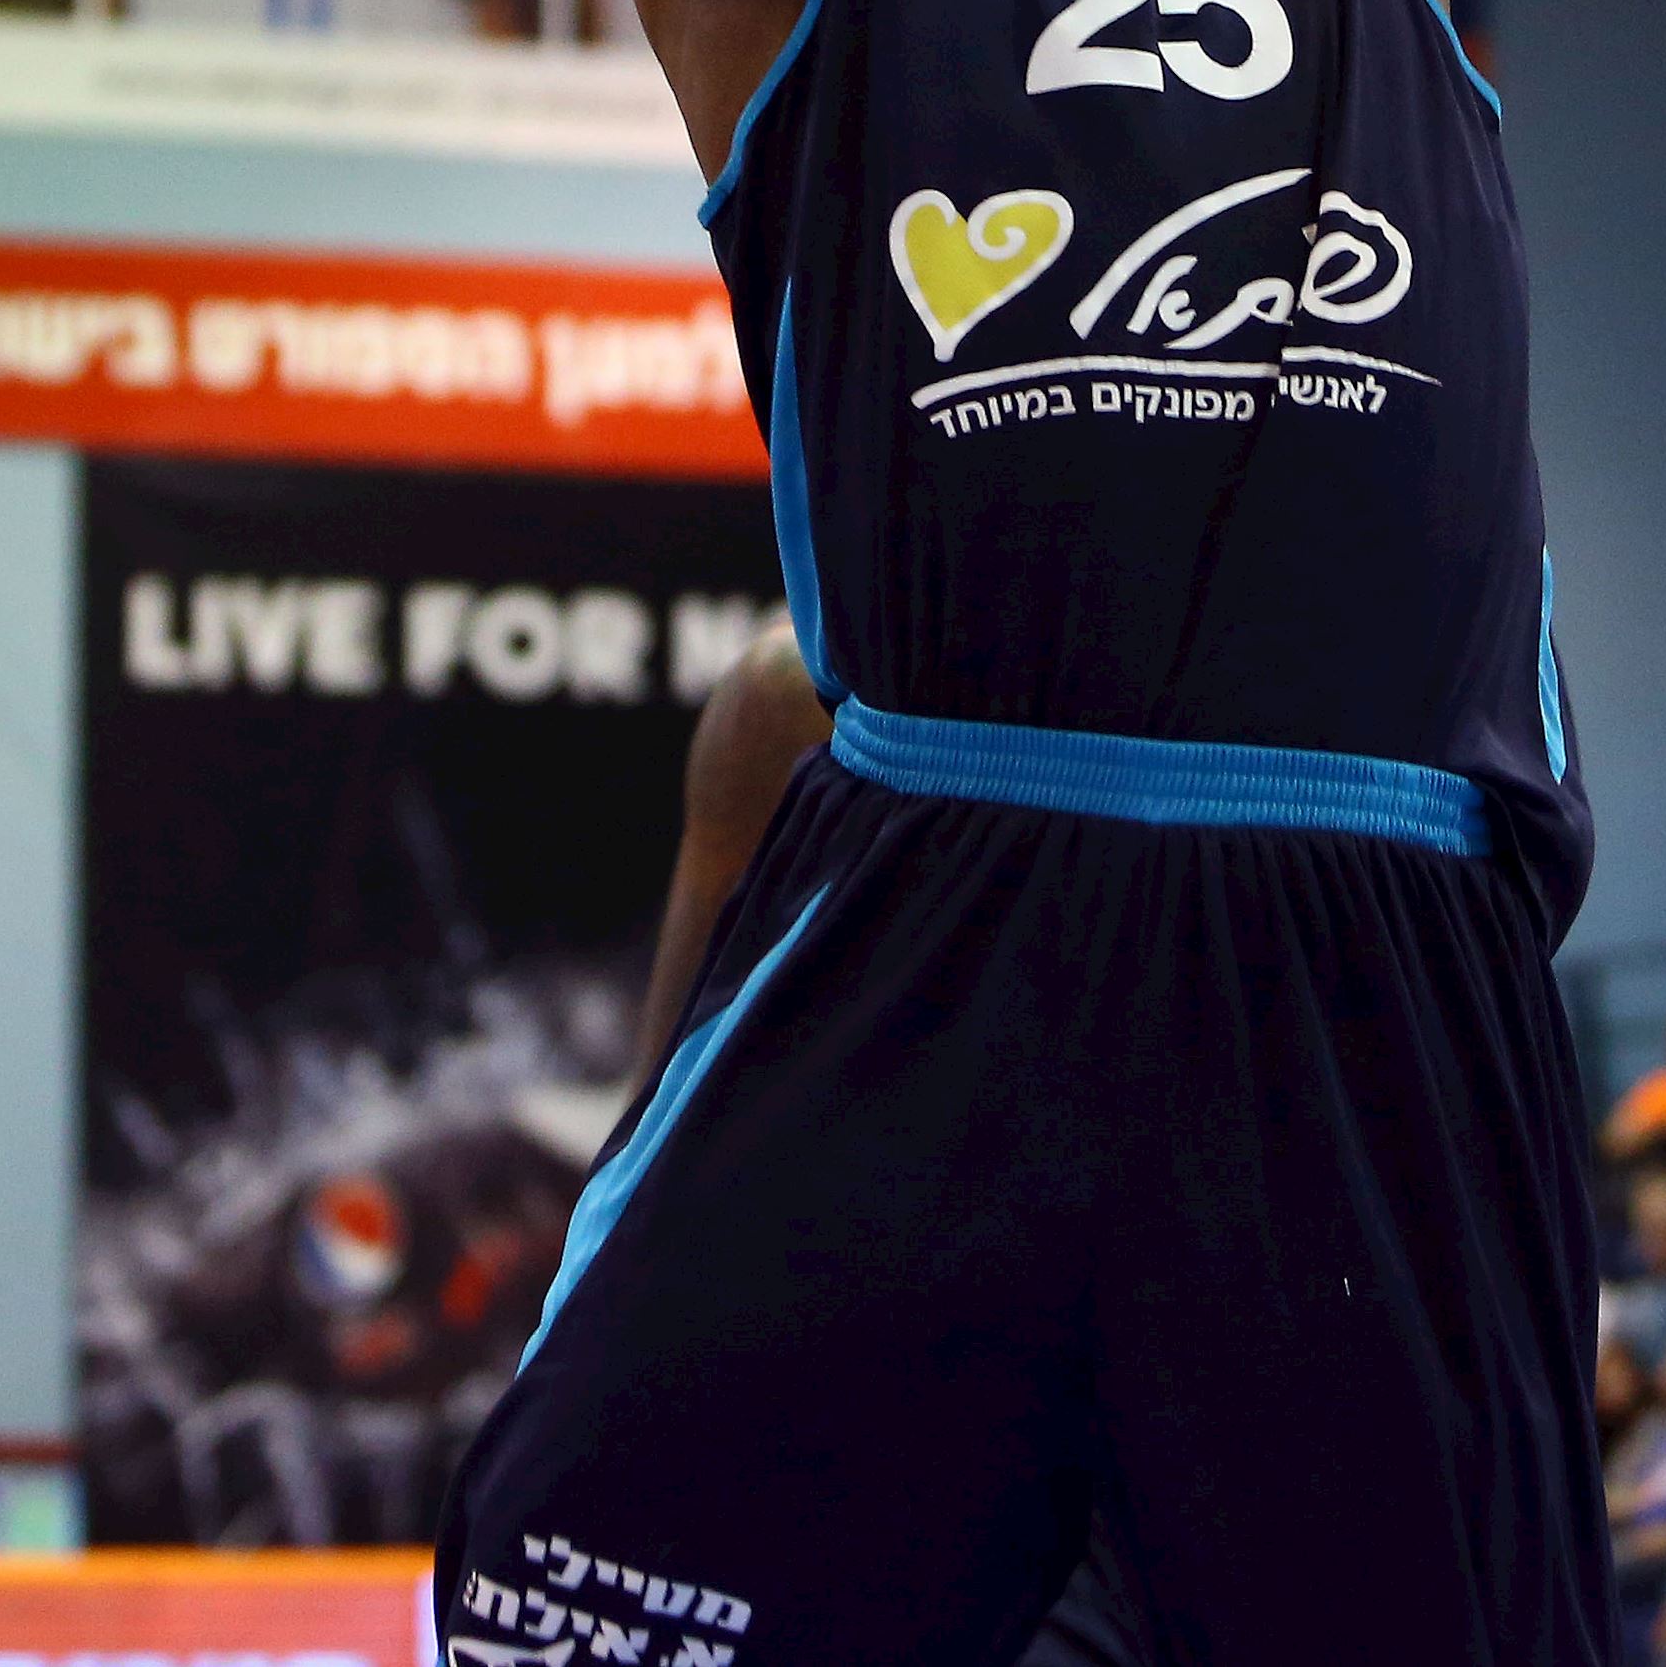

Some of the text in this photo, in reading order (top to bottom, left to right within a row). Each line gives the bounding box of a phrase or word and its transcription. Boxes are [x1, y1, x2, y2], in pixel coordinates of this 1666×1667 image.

[188, 297, 531, 404] הספורט
[930, 373, 1388, 439] לאנשי מפונקים במיוחד
[123, 574, 384, 697] LIVE
[401, 581, 651, 706] FOR
